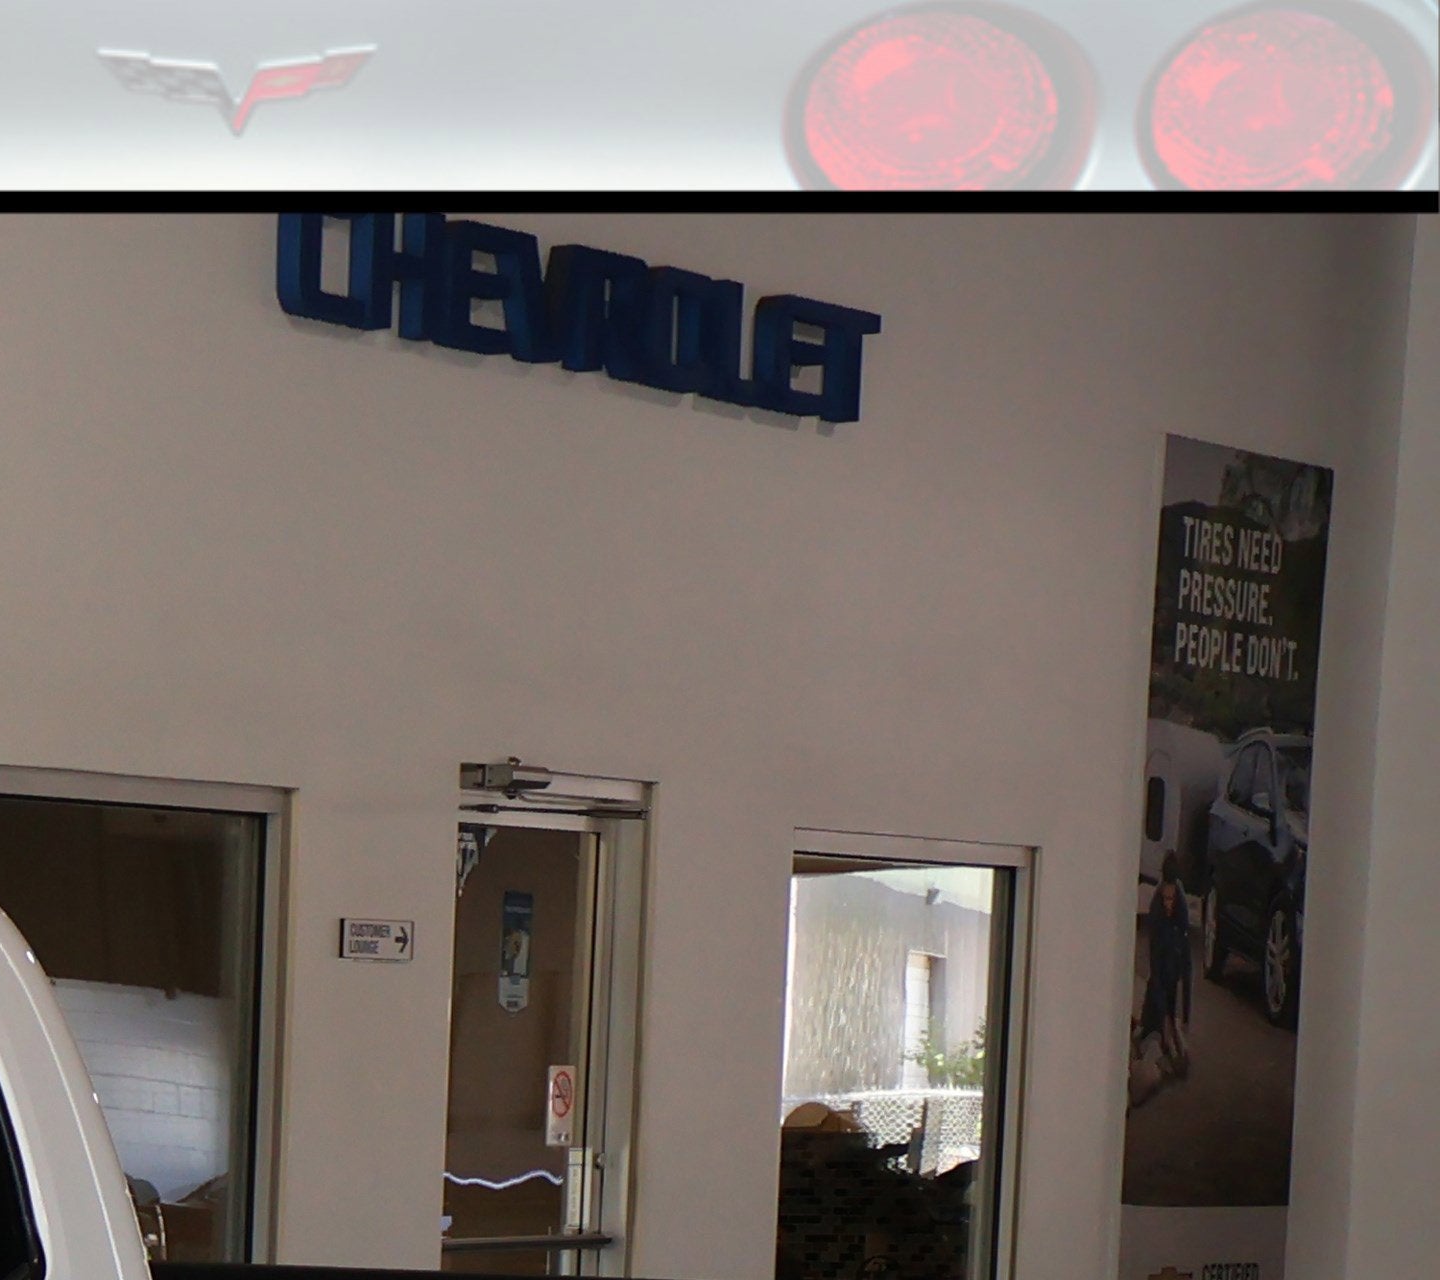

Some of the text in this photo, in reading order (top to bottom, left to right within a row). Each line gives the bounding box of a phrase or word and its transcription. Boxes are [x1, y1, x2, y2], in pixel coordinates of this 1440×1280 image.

[277, 212, 881, 423] CHEVROLET
[1183, 516, 1283, 575] TIRES NEED
[1178, 568, 1273, 626] PRESSURE.
[1174, 622, 1299, 682] PEOPLE DON'T.
